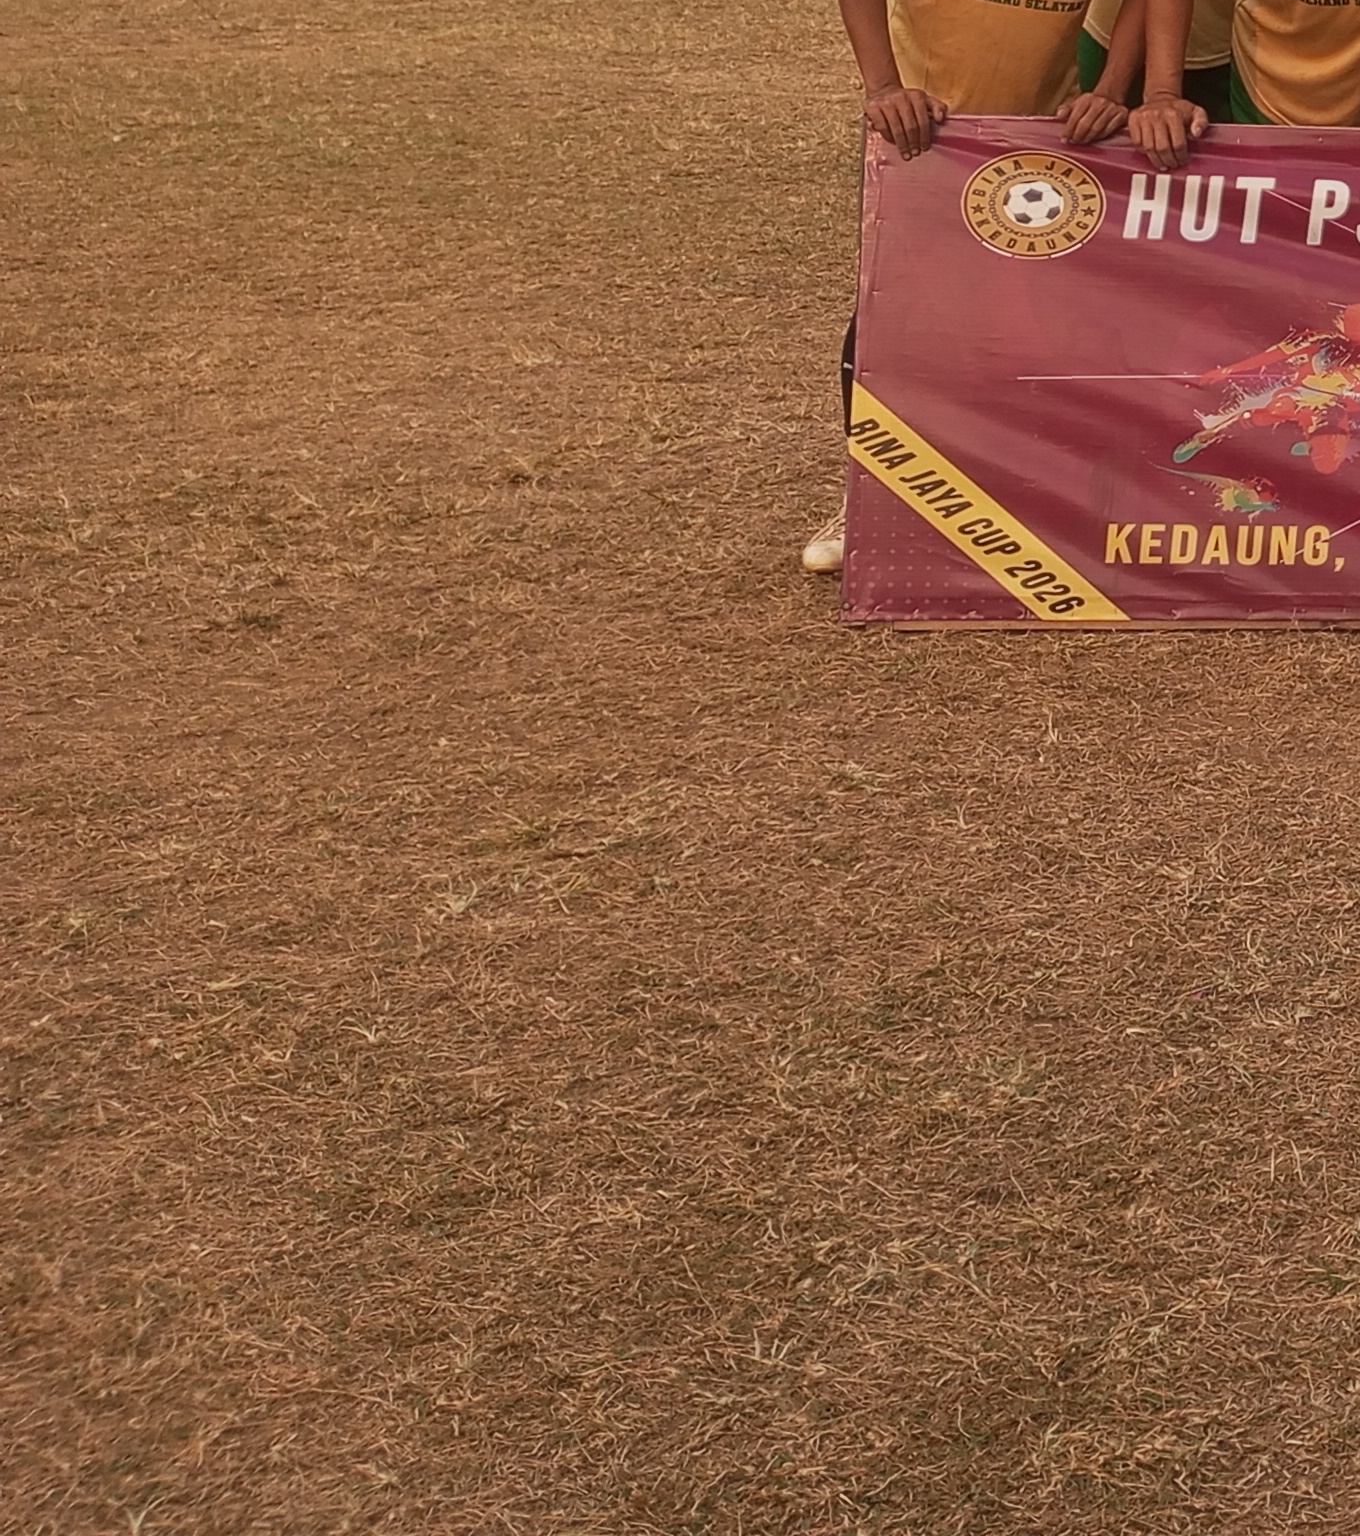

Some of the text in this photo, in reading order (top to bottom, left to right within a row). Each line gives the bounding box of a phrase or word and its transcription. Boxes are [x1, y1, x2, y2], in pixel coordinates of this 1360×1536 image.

[972, 159, 1096, 201] BINA JAYA
[1122, 173, 1277, 244] HUT
[975, 220, 1090, 253] KEDAUNG
[850, 418, 1085, 614] BINA JAYA CUP 2026
[1105, 523, 1345, 572] KEDAUNG,
